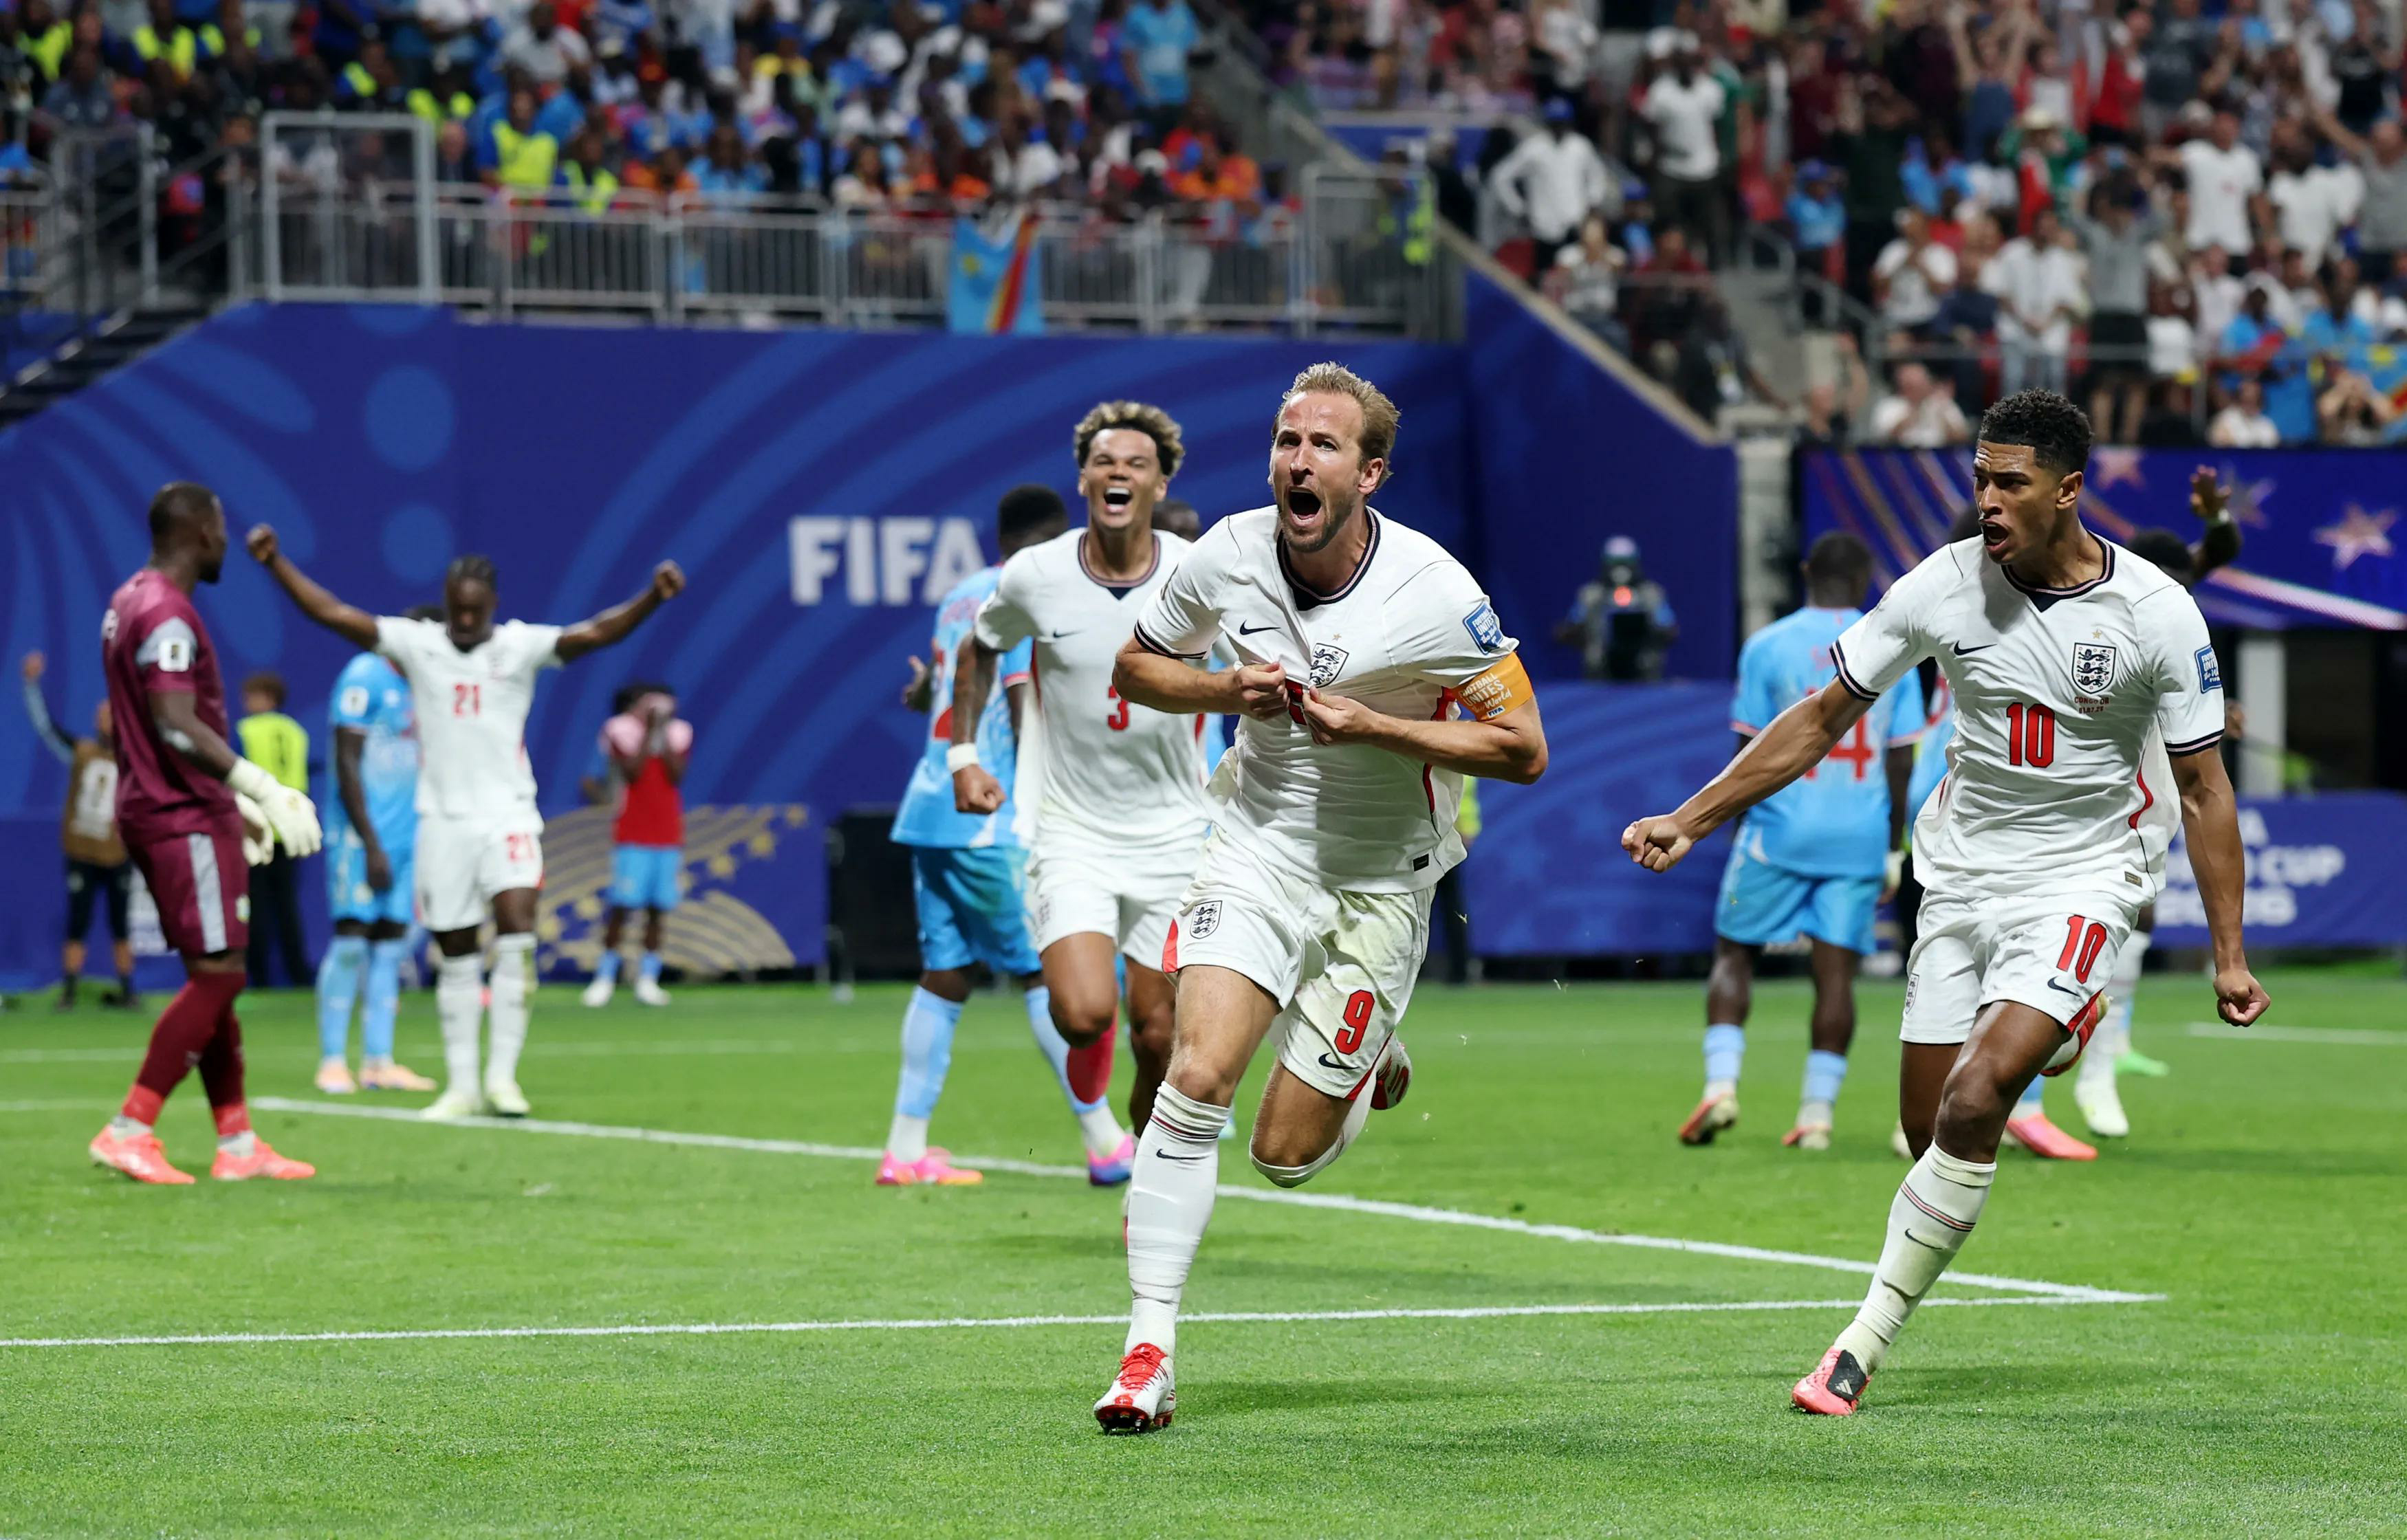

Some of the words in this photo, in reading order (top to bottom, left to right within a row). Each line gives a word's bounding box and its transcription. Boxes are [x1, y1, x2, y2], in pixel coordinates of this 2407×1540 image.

[792, 517, 985, 606] FIFA
[1476, 615, 1495, 636] UNITES
[454, 683, 481, 716] 21
[1108, 684, 1130, 731] 3
[1462, 679, 1505, 706] UNITES
[1485, 688, 1512, 710] World
[2074, 696, 2098, 705] CONGO
[1488, 707, 1503, 717] FIFA
[2006, 702, 2056, 768] 10
[506, 833, 535, 861] 21
[2259, 845, 2344, 886] CUP
[2056, 914, 2107, 984] 10
[1334, 989, 1375, 1055] 9
